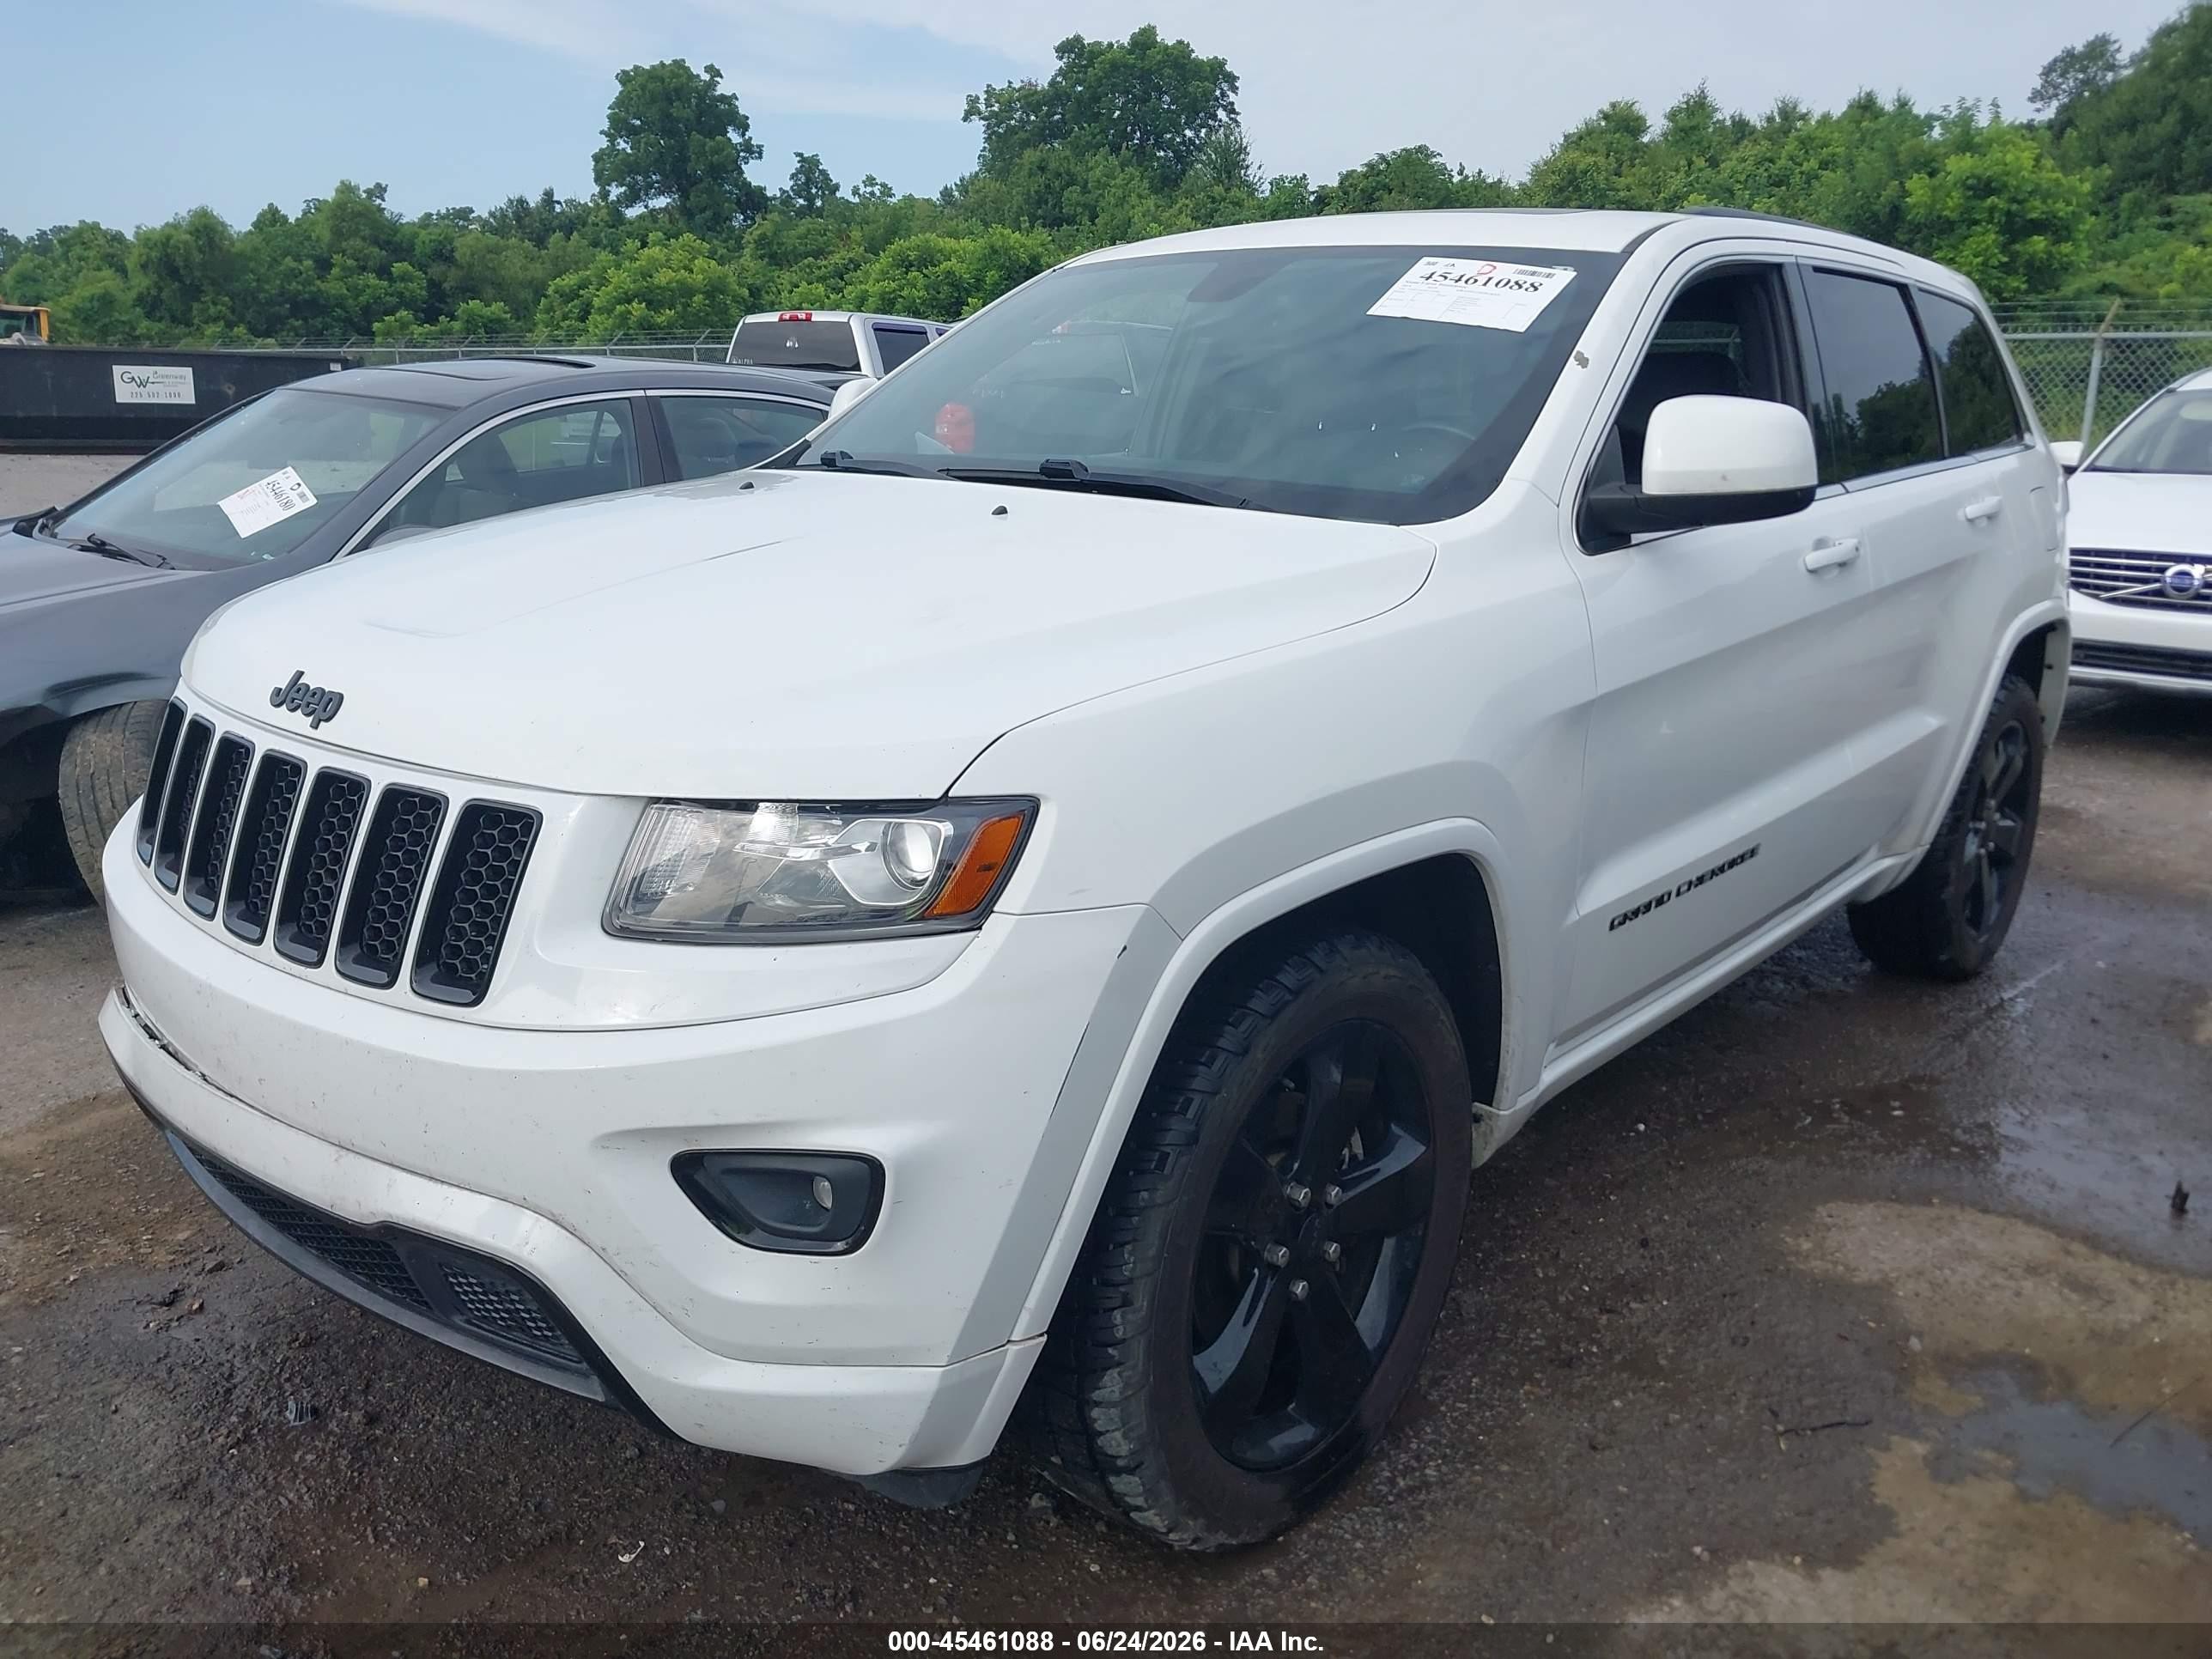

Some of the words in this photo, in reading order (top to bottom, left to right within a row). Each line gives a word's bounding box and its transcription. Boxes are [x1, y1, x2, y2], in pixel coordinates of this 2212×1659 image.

[1420, 270, 1543, 293] 45461088
[120, 371, 149, 388] GW
[270, 670, 344, 731] Jeep
[1608, 889, 1673, 932] GRAND
[1674, 842, 1761, 898] CHEROKEE
